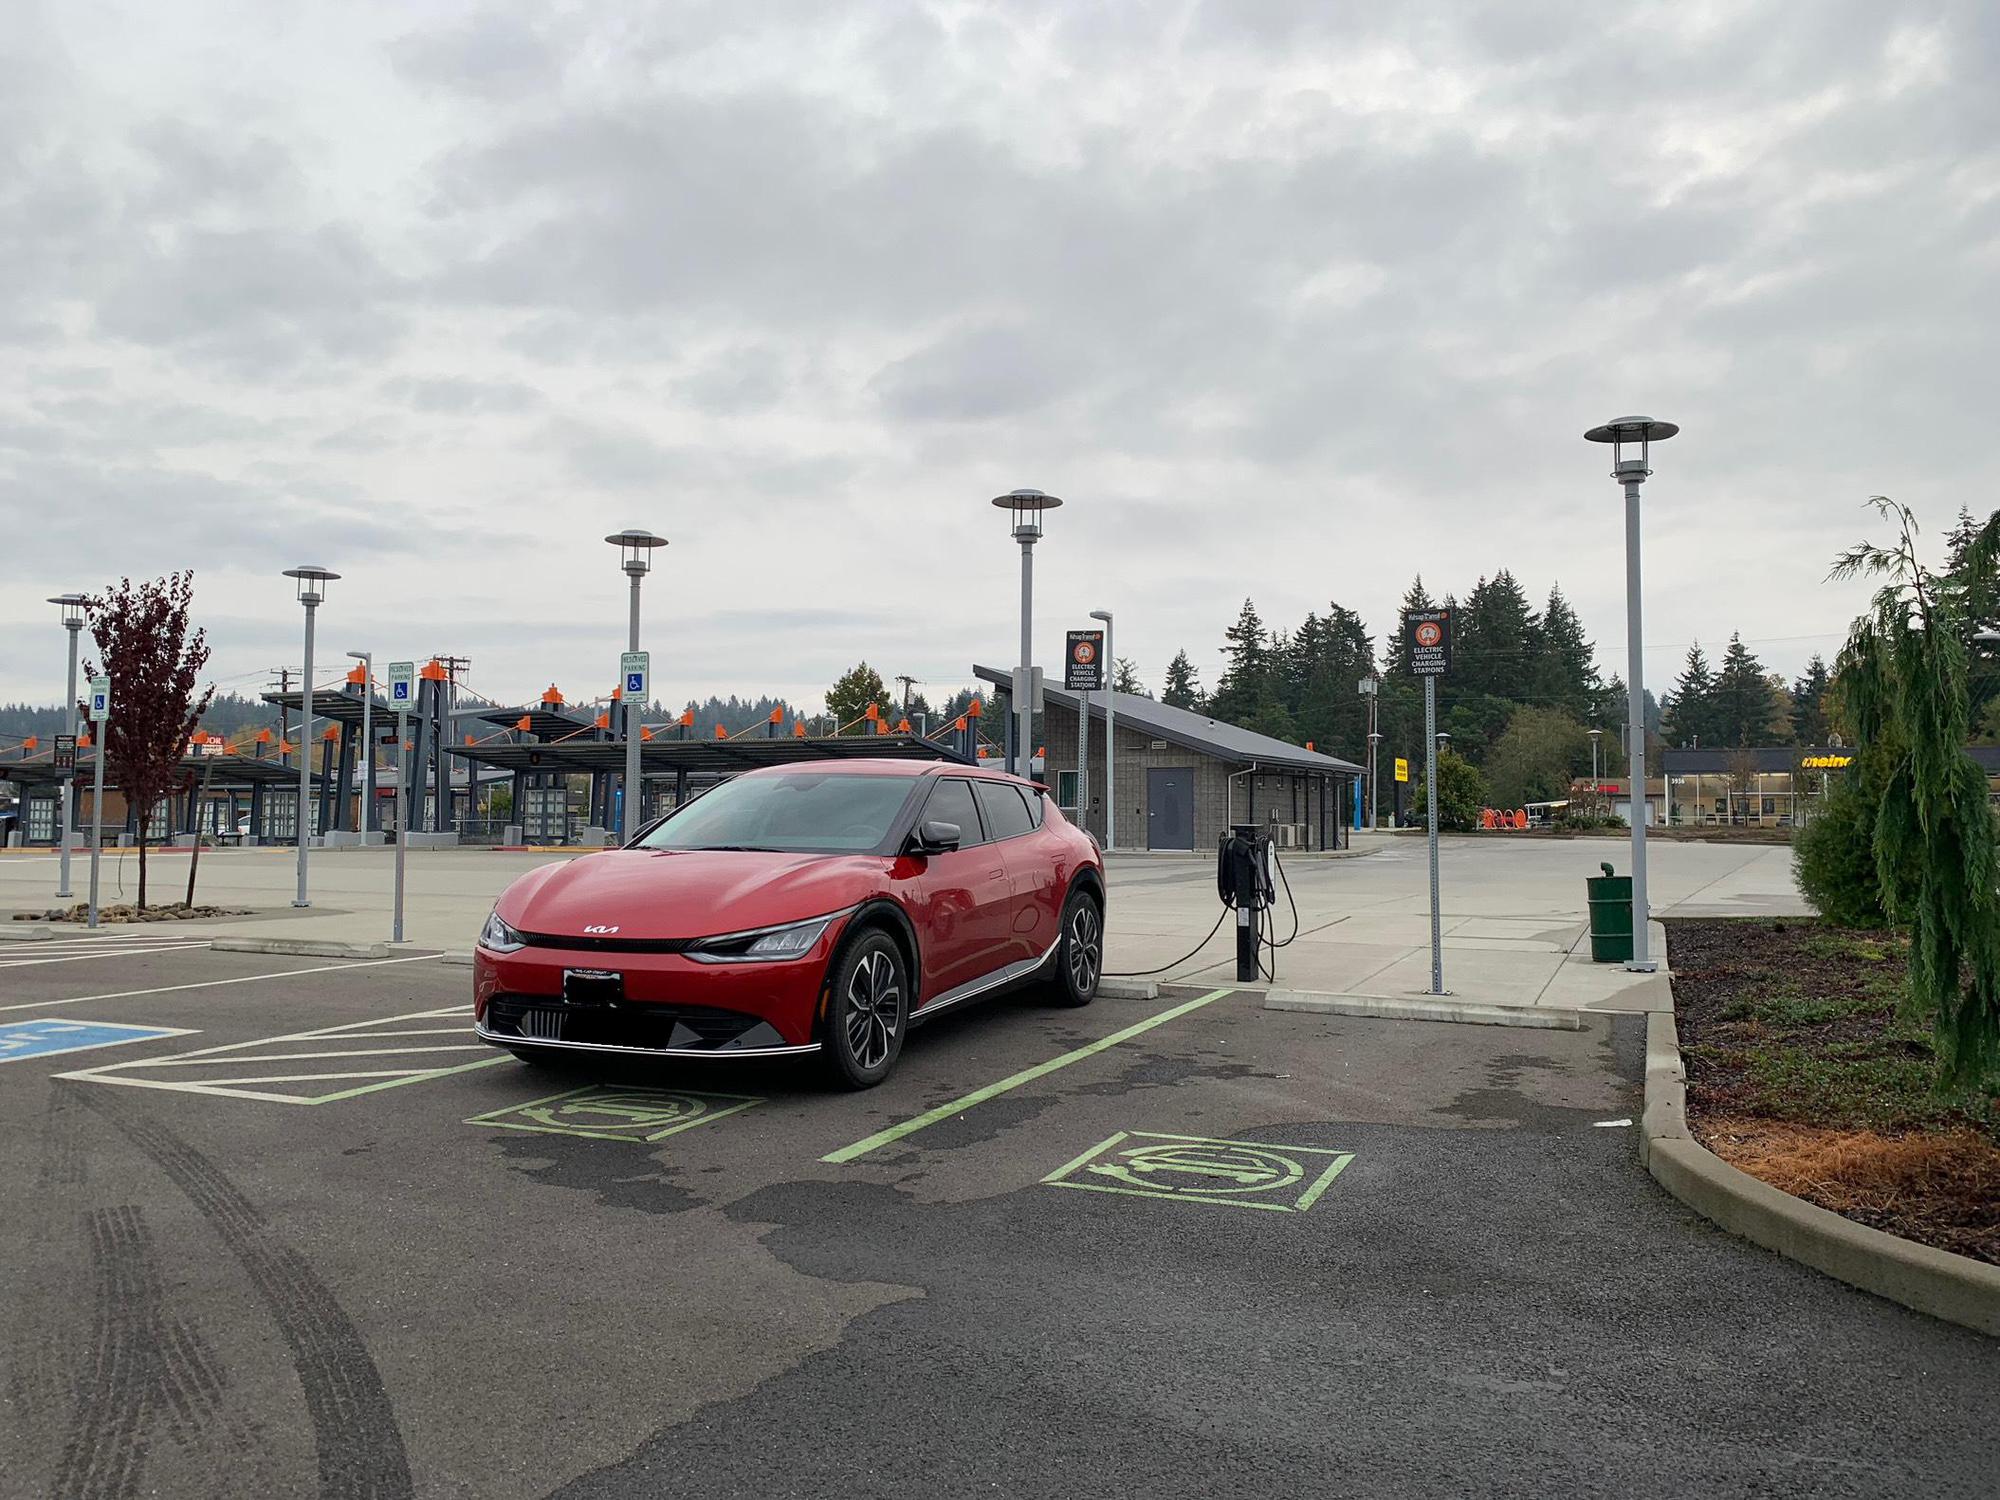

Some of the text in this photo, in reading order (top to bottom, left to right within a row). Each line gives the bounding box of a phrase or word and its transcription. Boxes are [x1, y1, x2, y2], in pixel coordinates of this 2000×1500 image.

[1413, 646, 1444, 654] ELECTRIC
[1415, 653, 1442, 661] VEHICLE
[623, 664, 646, 672] PARKING
[1413, 666, 1445, 674] STATIONS
